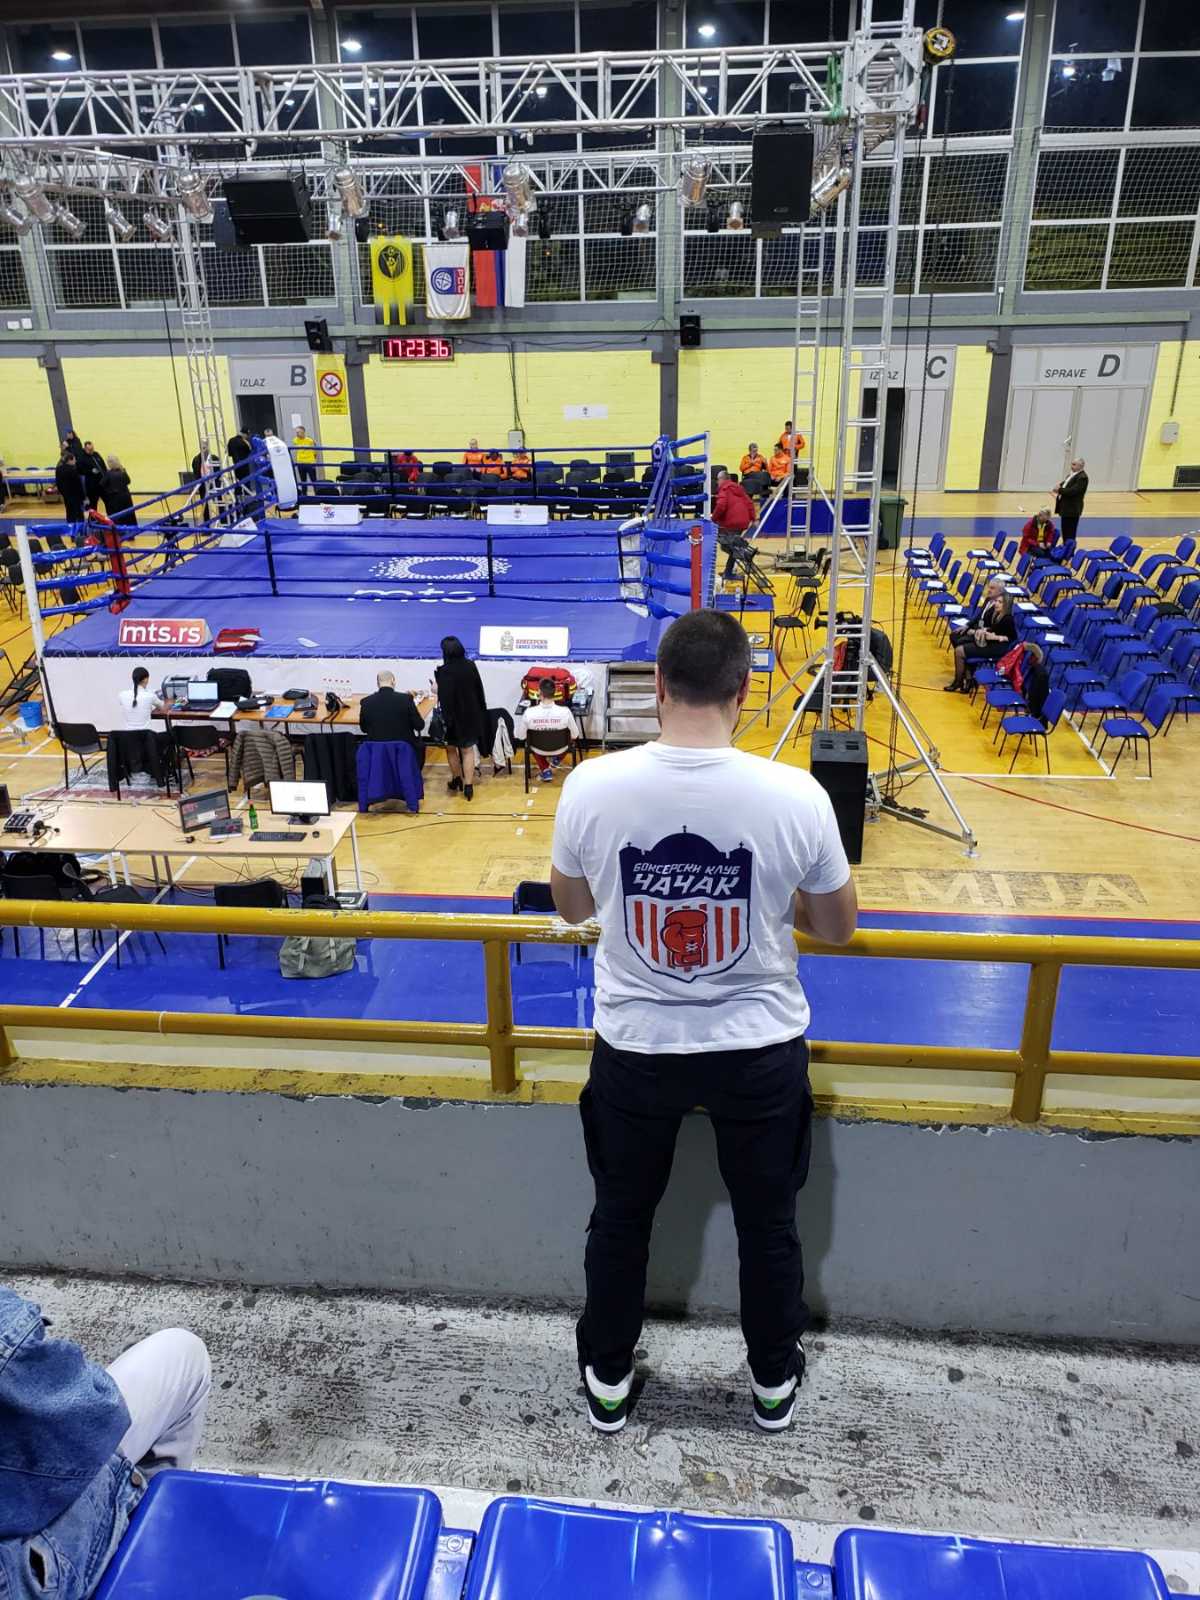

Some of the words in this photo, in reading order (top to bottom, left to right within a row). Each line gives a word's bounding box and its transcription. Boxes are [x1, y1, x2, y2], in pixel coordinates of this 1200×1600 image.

[240, 378, 265, 387] IZLAZ
[290, 365, 307, 386] B
[869, 371, 899, 380] IZAZ
[926, 355, 947, 379] C
[1044, 369, 1087, 378] SPRAVE
[1097, 354, 1121, 377] D
[122, 623, 201, 643] mts.rs
[633, 863, 702, 875] БОКСЕРСКИ
[704, 865, 741, 876] КЛУБ
[632, 873, 740, 896] ЧАЧАК
